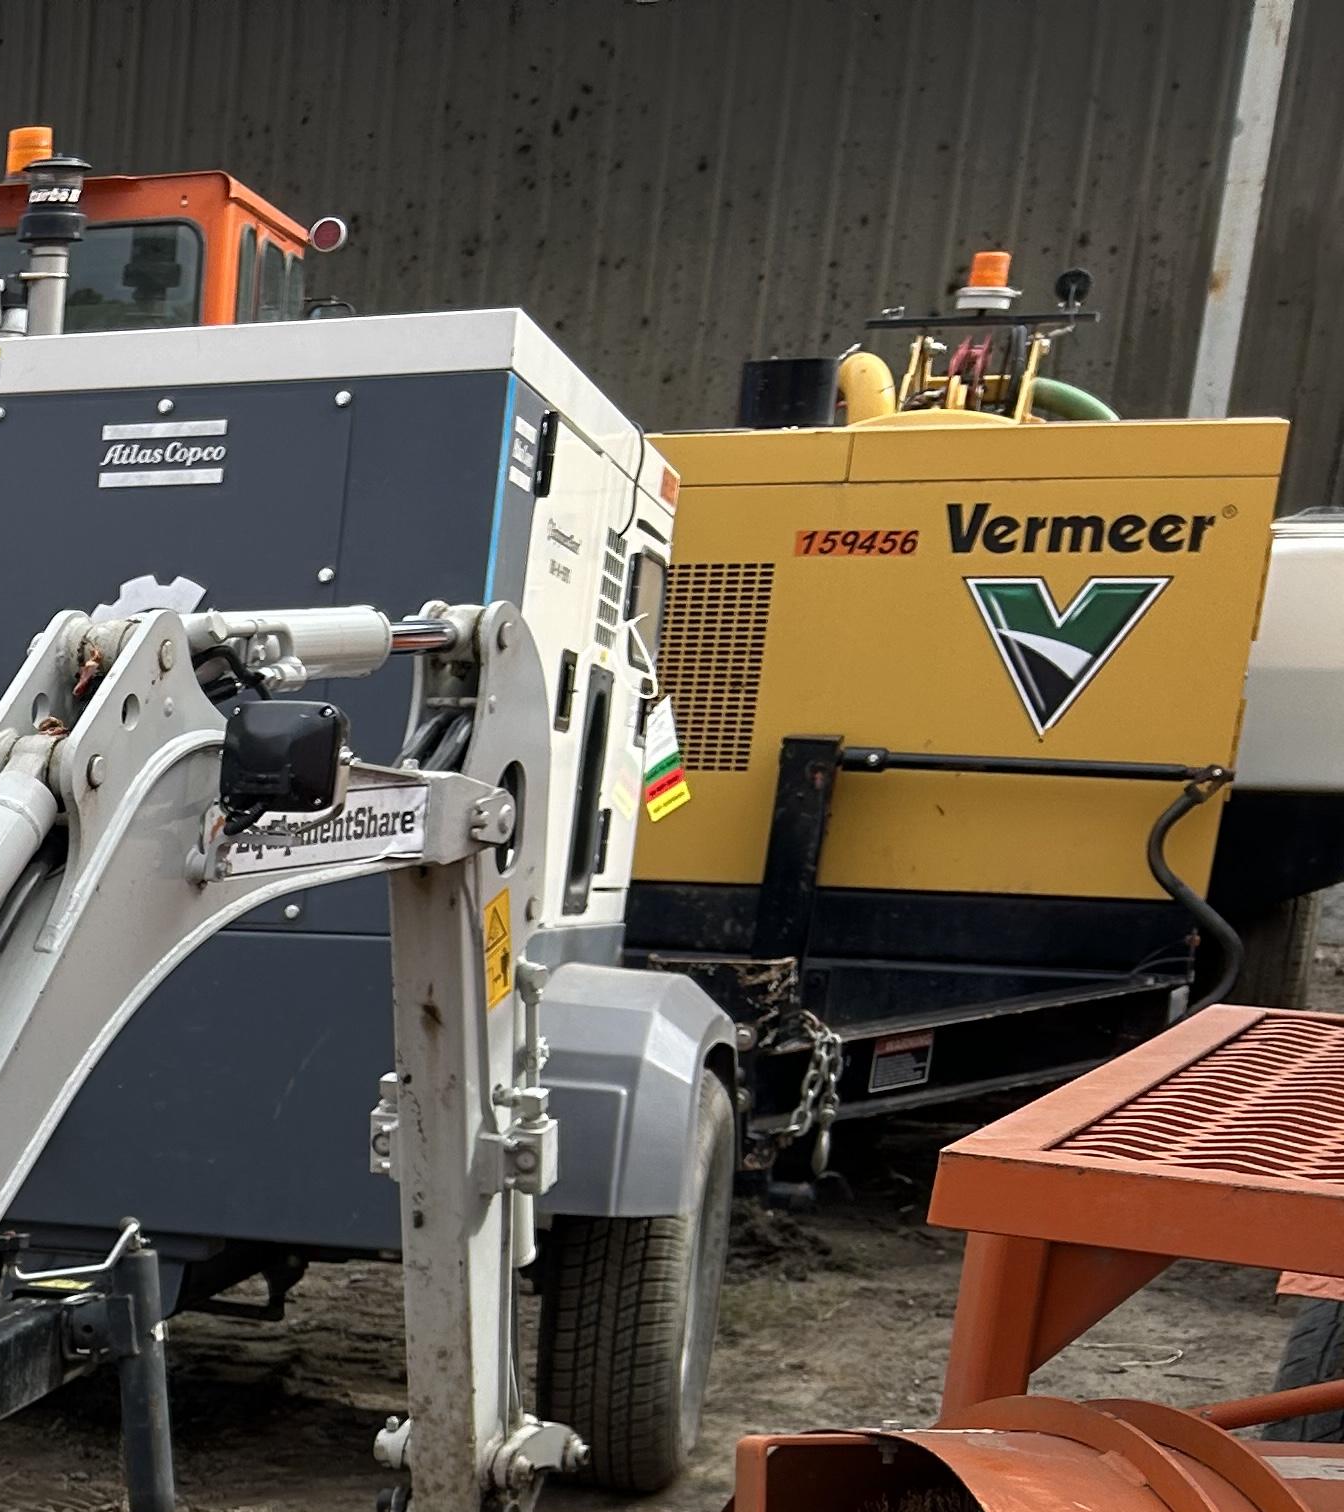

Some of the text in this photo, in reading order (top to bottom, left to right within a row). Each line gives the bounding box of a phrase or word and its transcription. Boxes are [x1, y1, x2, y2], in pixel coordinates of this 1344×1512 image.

[99, 441, 227, 466] Atlas Copco
[946, 502, 1216, 554] Vermeer
[801, 530, 919, 554] 159456
